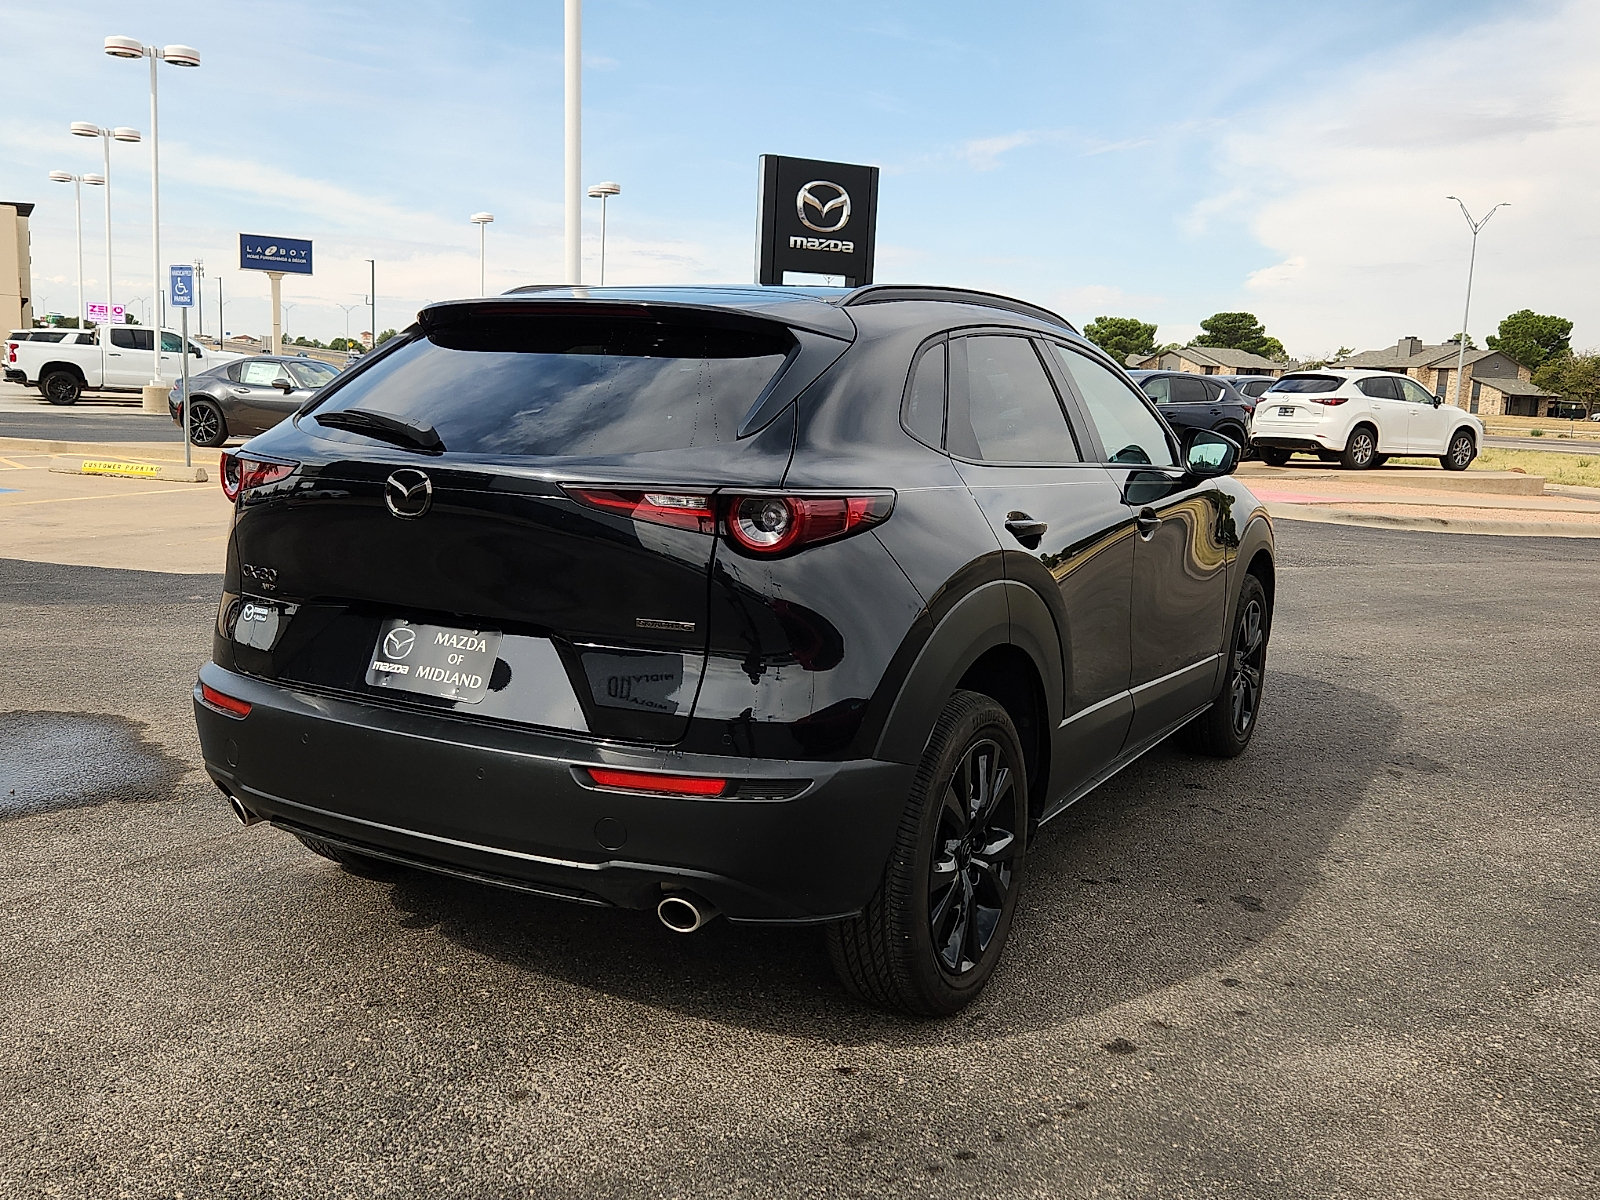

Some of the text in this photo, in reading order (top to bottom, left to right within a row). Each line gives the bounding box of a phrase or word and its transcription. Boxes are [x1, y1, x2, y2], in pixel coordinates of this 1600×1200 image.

[789, 235, 854, 254] mazda
[89, 304, 124, 314] ZEO
[83, 462, 122, 470] CUSTOMER
[433, 631, 486, 653] MAZDA
[447, 653, 465, 666] OF
[371, 660, 410, 675] mazda
[415, 665, 482, 689] MIDLAND
